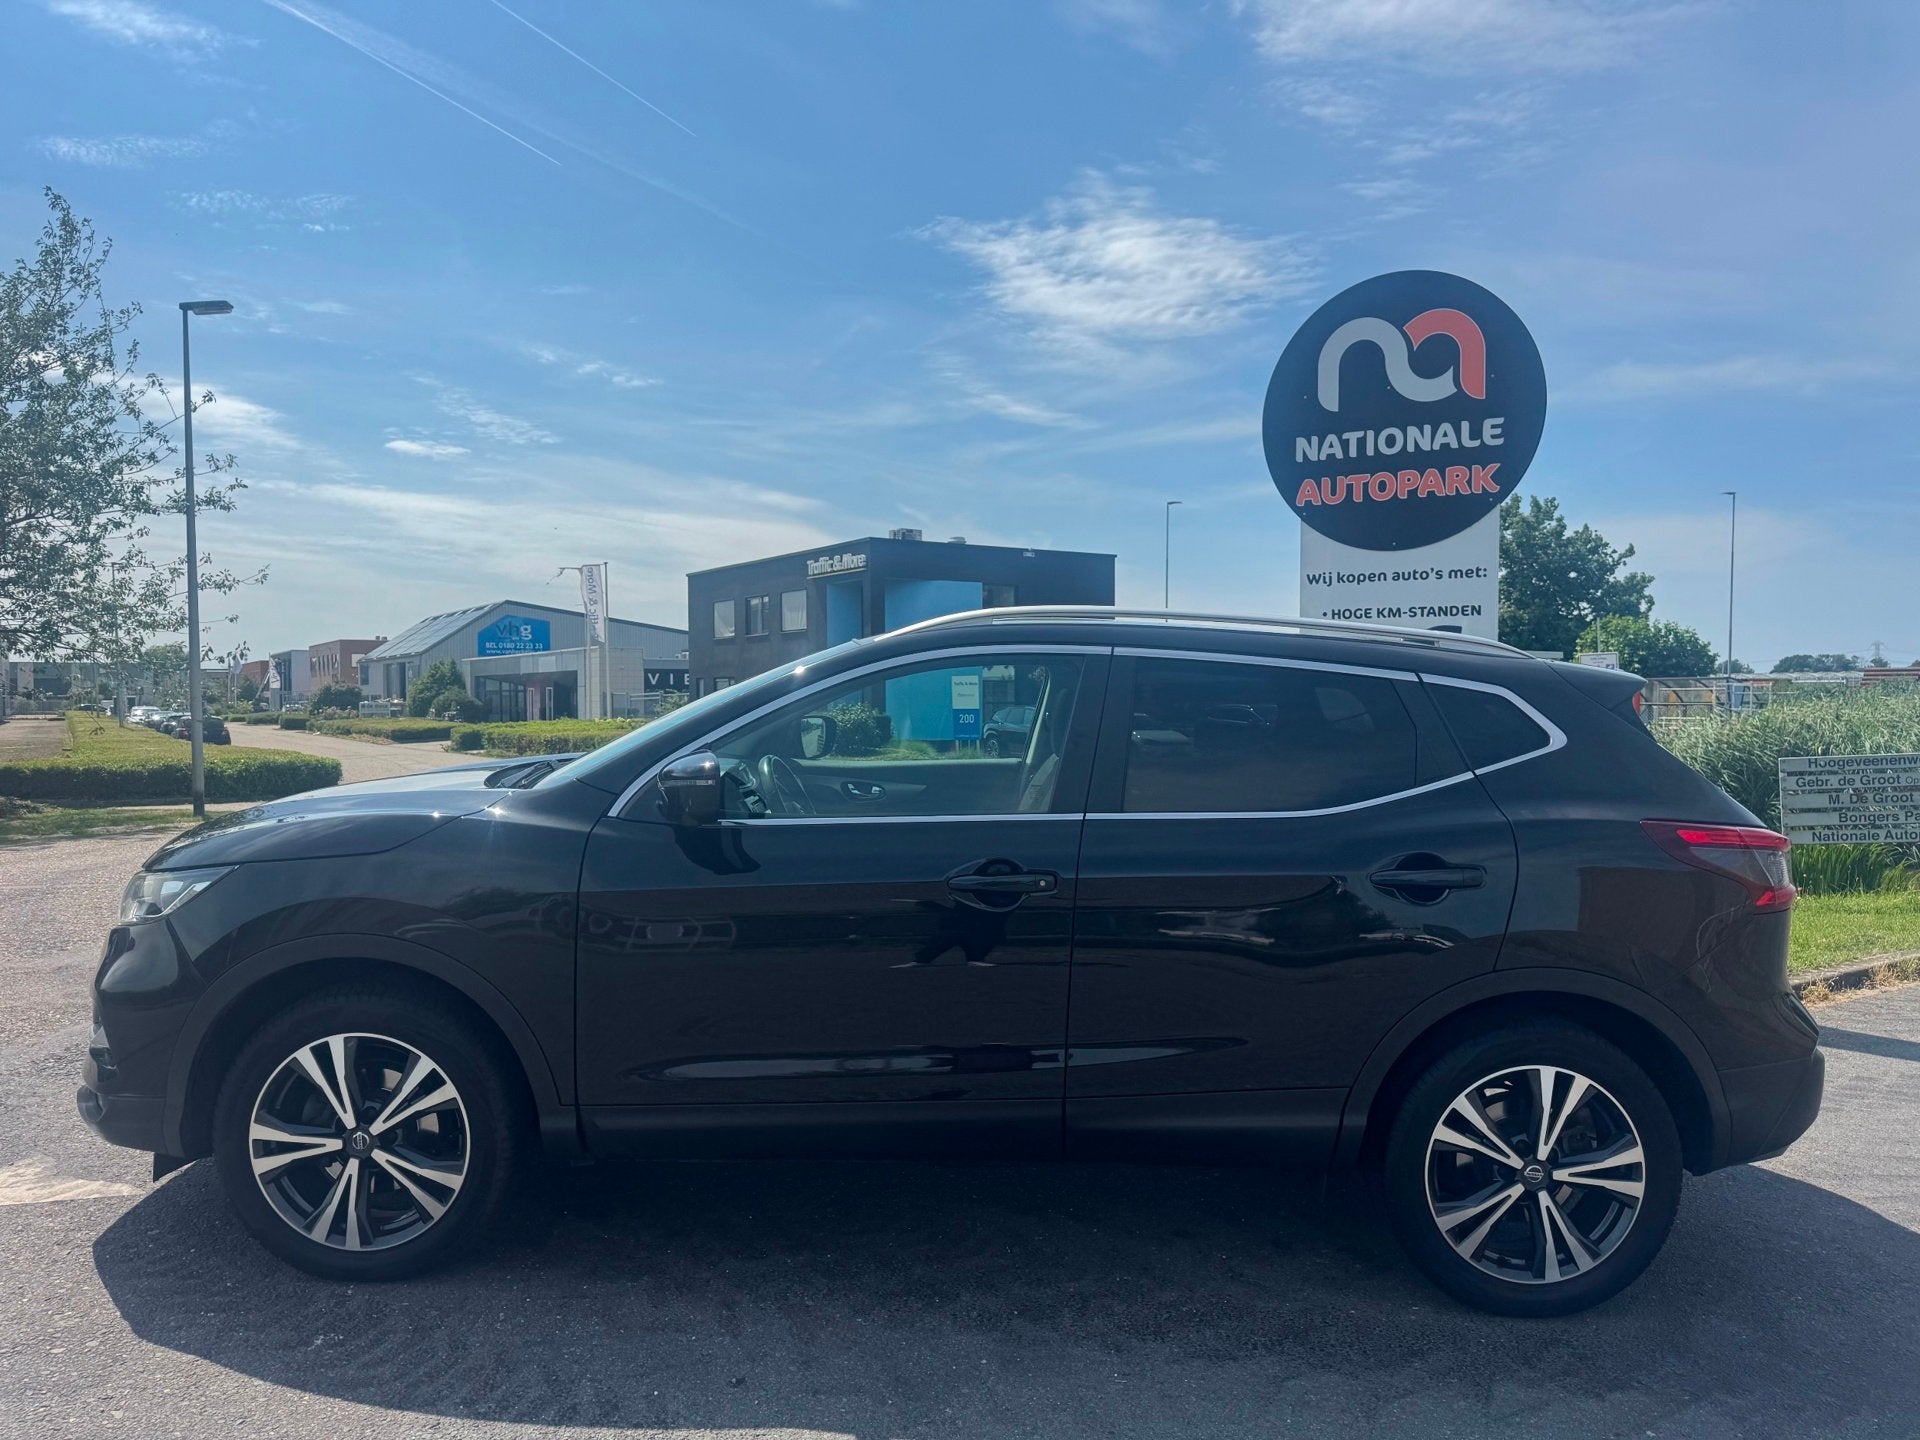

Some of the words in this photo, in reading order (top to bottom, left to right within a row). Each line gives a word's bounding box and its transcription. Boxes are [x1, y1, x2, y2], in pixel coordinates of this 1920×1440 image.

[1296, 417, 1505, 463] NATIONALE
[1296, 463, 1501, 507] AUTOPARK
[1306, 572, 1333, 587] Wij
[1336, 570, 1387, 586] kopen
[1391, 567, 1443, 582] auto's
[1448, 566, 1488, 579] met:
[1331, 608, 1372, 620] HOGE
[1376, 605, 1482, 618] KM-STANDEN
[959, 714, 975, 723] 200
[1808, 757, 1920, 770] Hoogeveenenw
[1796, 776, 1833, 788] Gebr.
[1838, 776, 1855, 787] de
[1860, 774, 1901, 786] Groot
[1828, 794, 1845, 805] M.
[1849, 793, 1869, 804] De
[1873, 792, 1914, 803] Groot
[1839, 812, 1900, 824] Bongers
[1811, 831, 1880, 843] Nationale
[1884, 829, 1920, 841] Auto
